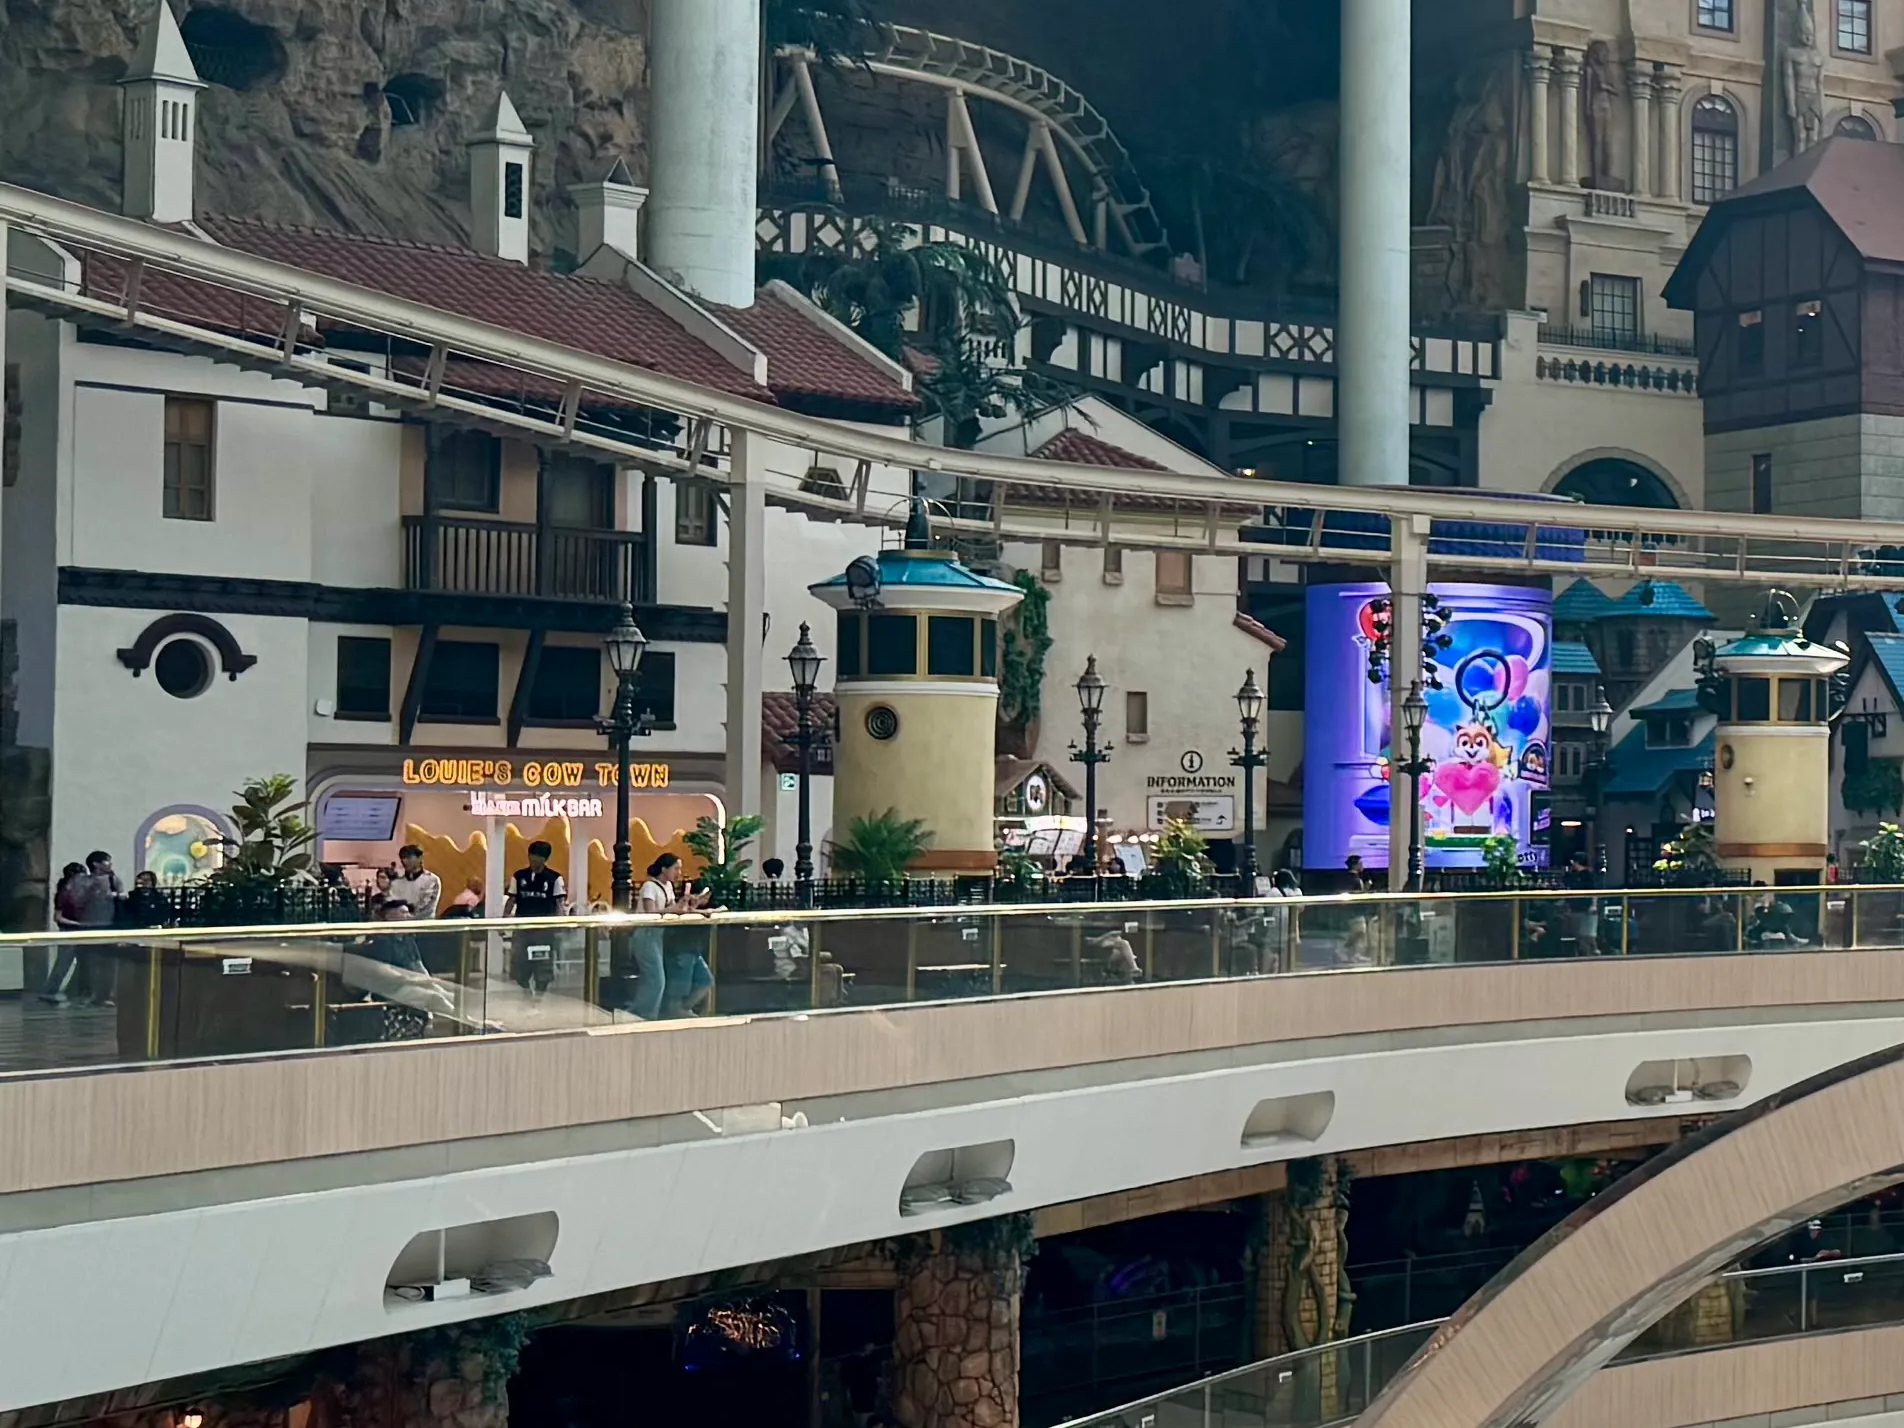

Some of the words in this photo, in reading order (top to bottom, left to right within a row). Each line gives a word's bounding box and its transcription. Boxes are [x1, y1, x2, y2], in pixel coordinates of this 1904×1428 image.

[403, 759, 512, 785] LOUIE'S
[523, 762, 584, 786] COW
[1147, 776, 1235, 788] INFORMATION
